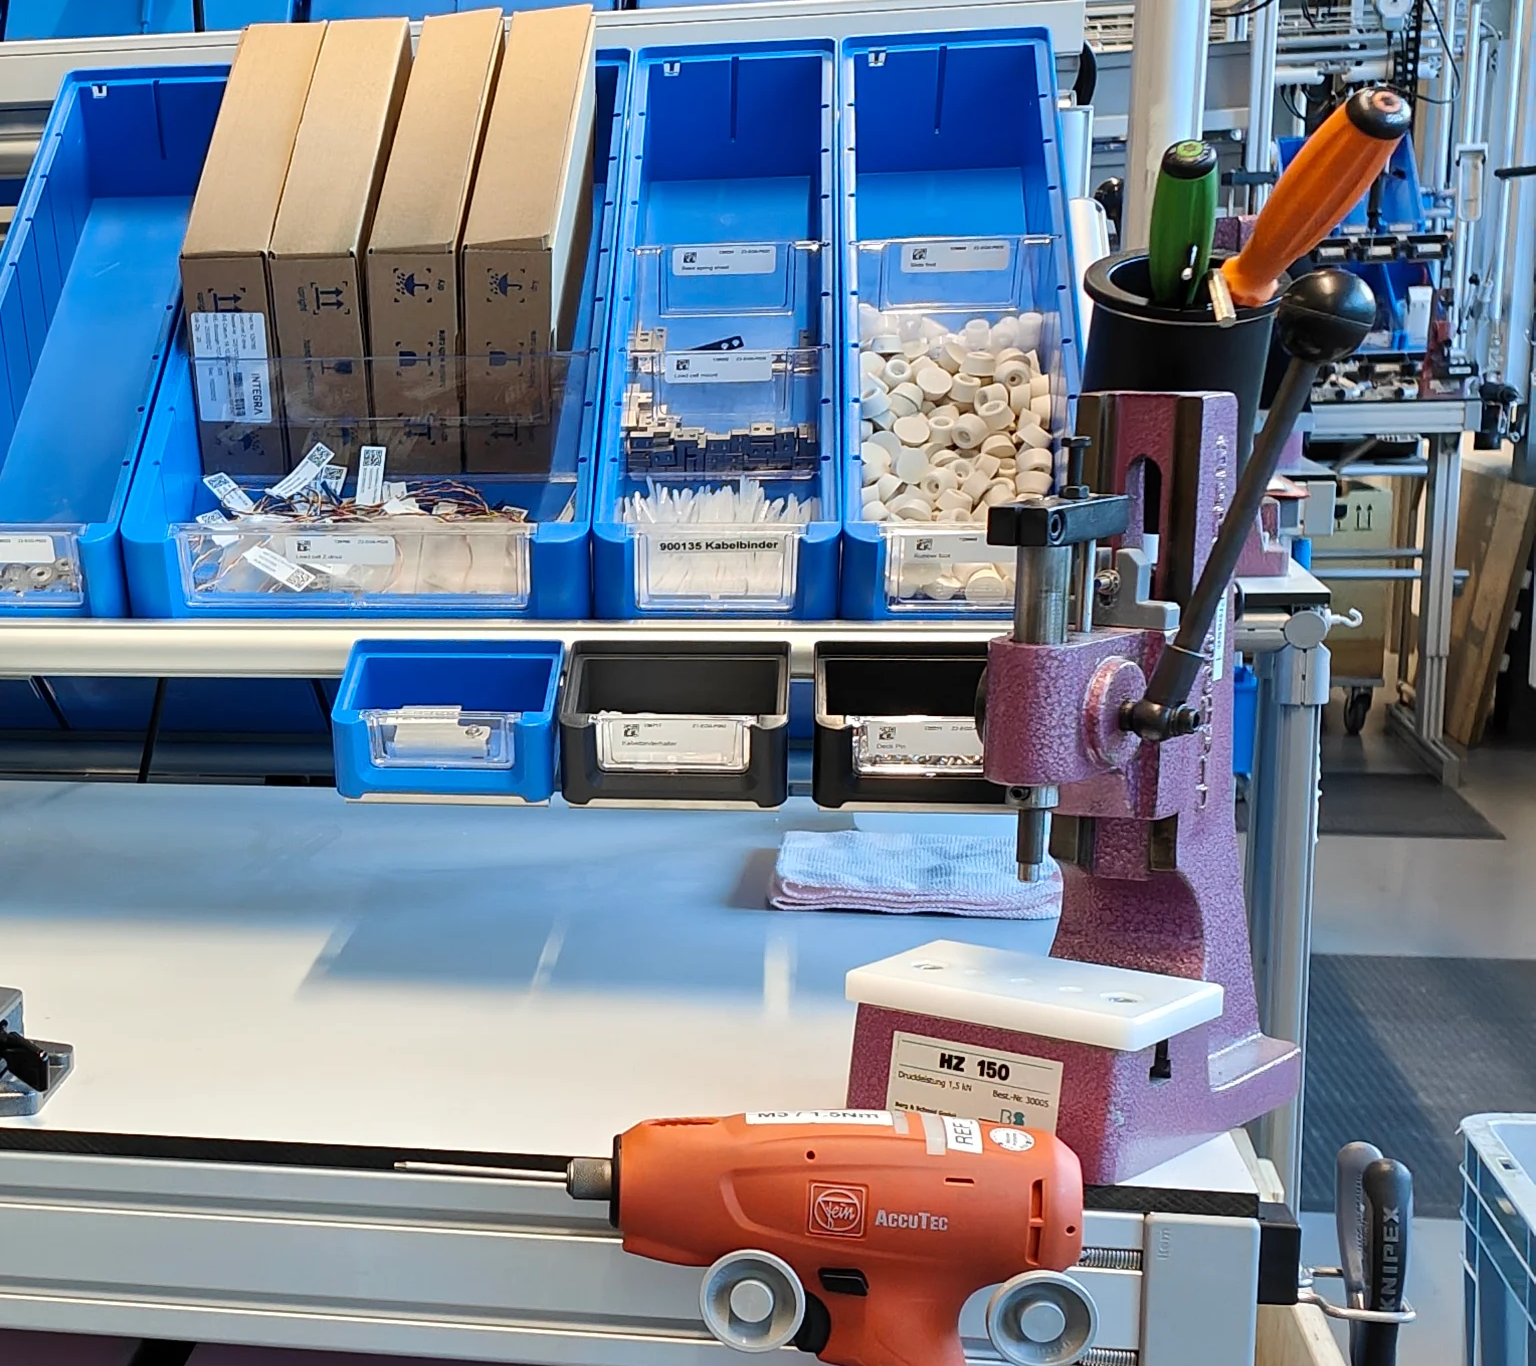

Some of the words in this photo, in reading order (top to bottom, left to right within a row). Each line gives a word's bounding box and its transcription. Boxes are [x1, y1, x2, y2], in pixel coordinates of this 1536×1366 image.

[251, 373, 264, 416] INTEGRA
[659, 540, 701, 553] 900135
[704, 537, 779, 552] Kabelbinder
[898, 1070, 946, 1089] Druckleistung
[939, 1053, 966, 1072] HZ
[977, 1059, 1010, 1081] 150
[1380, 1206, 1400, 1311] KNIPEX
